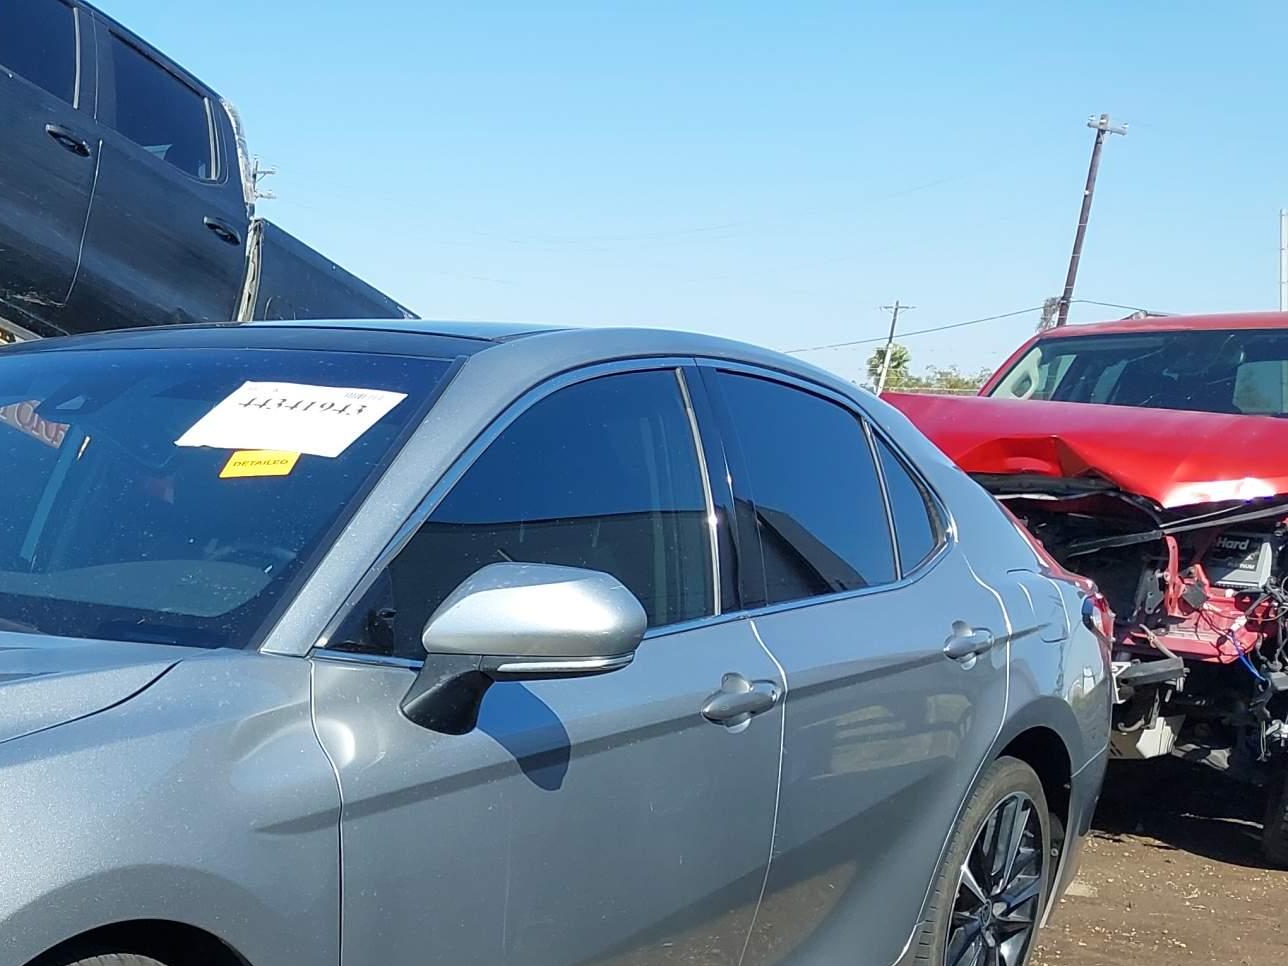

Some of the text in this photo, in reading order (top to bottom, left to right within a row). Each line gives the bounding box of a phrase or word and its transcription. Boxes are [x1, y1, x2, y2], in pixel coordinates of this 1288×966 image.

[238, 397, 368, 416] 44341943
[231, 458, 289, 468] DETAILED
[1215, 536, 1250, 551] Hard
